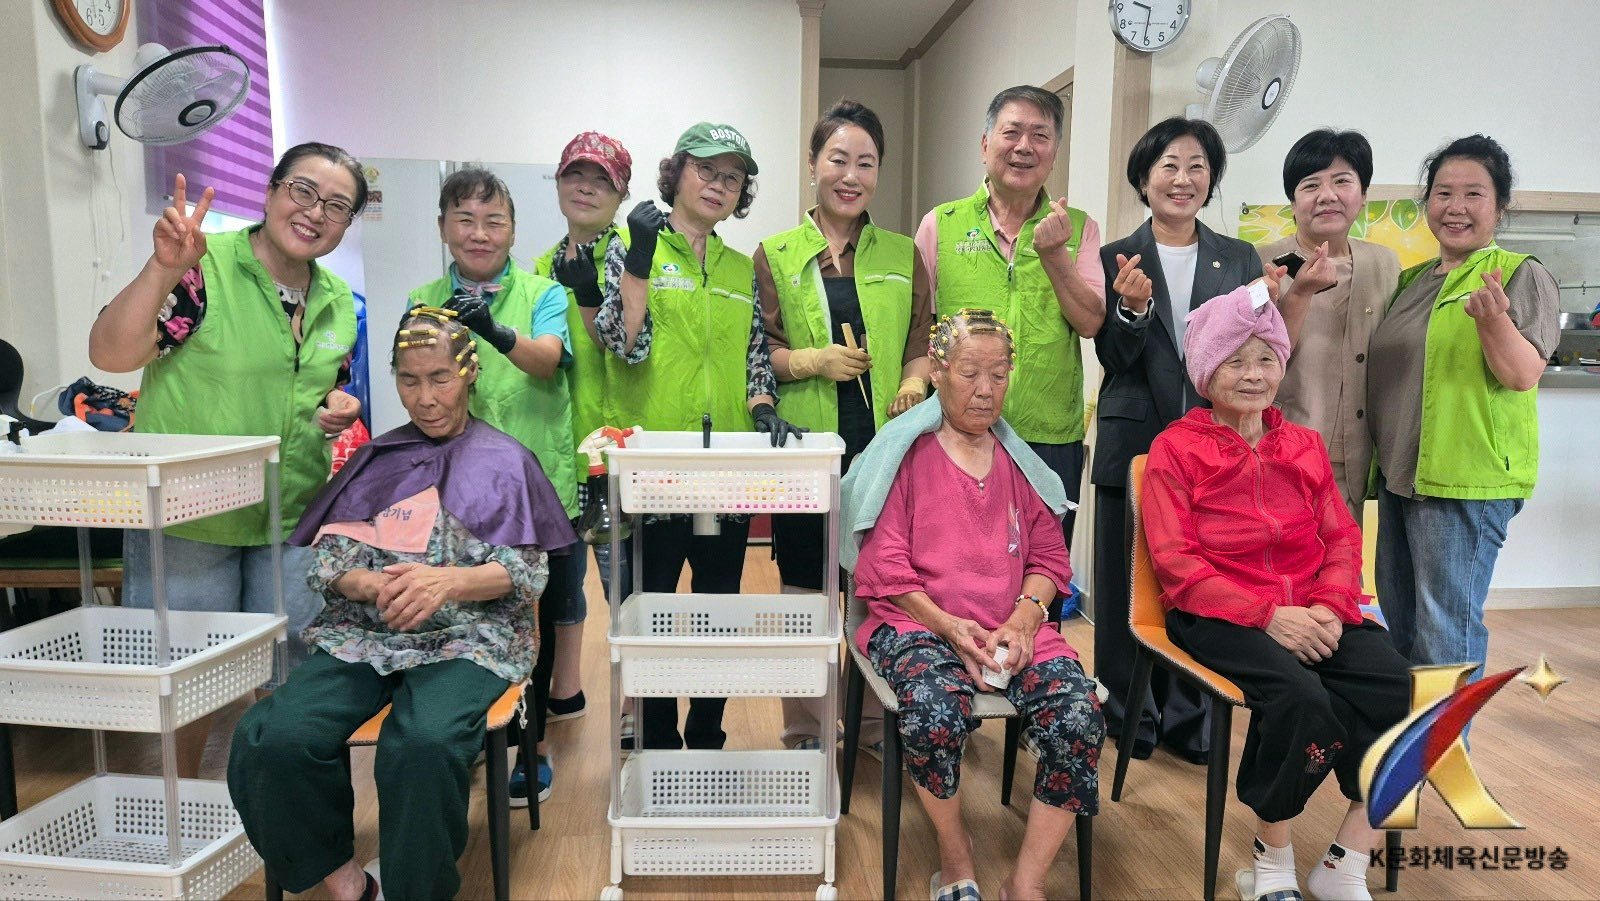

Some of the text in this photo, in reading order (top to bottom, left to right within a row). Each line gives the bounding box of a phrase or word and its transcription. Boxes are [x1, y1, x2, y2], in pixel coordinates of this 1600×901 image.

[1116, 2, 1124, 13] 9
[1176, 4, 1183, 15] 3
[86, 7, 94, 26] 6
[98, 8, 105, 26] 5
[1119, 18, 1127, 30] 8
[1169, 19, 1177, 31] 4
[1131, 30, 1138, 41] 7
[1143, 35, 1151, 47] 6
[1157, 31, 1165, 42] 5
